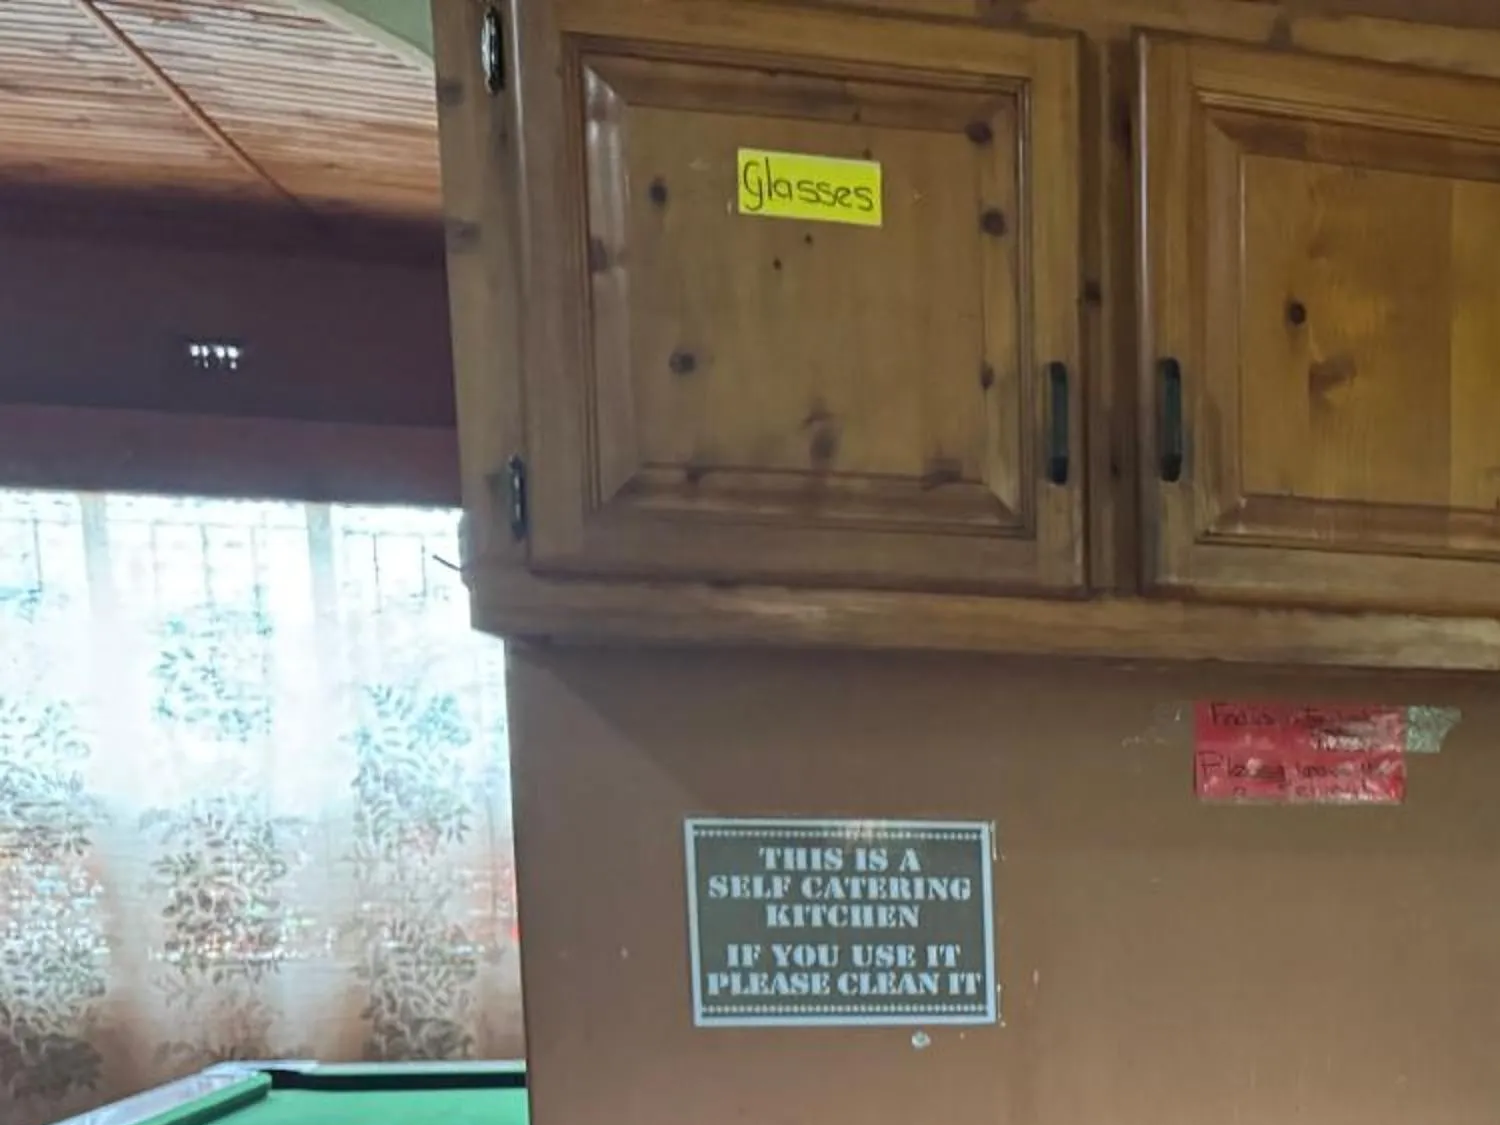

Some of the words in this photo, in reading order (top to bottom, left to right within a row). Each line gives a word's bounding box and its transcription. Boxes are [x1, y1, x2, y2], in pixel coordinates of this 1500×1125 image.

[743, 156, 874, 212] Glasses
[759, 847, 843, 871] THIS
[854, 847, 888, 871] IS
[899, 848, 921, 872] A
[708, 875, 792, 899] SELF
[801, 876, 971, 900] CATERING
[766, 904, 919, 928] KITCHEN
[727, 944, 761, 967] IF
[771, 944, 839, 967] YOU
[852, 944, 916, 967] USE
[926, 944, 961, 967] IT
[707, 972, 831, 996] PLEASE
[837, 972, 940, 996] CLEAN
[948, 972, 981, 995] IT
